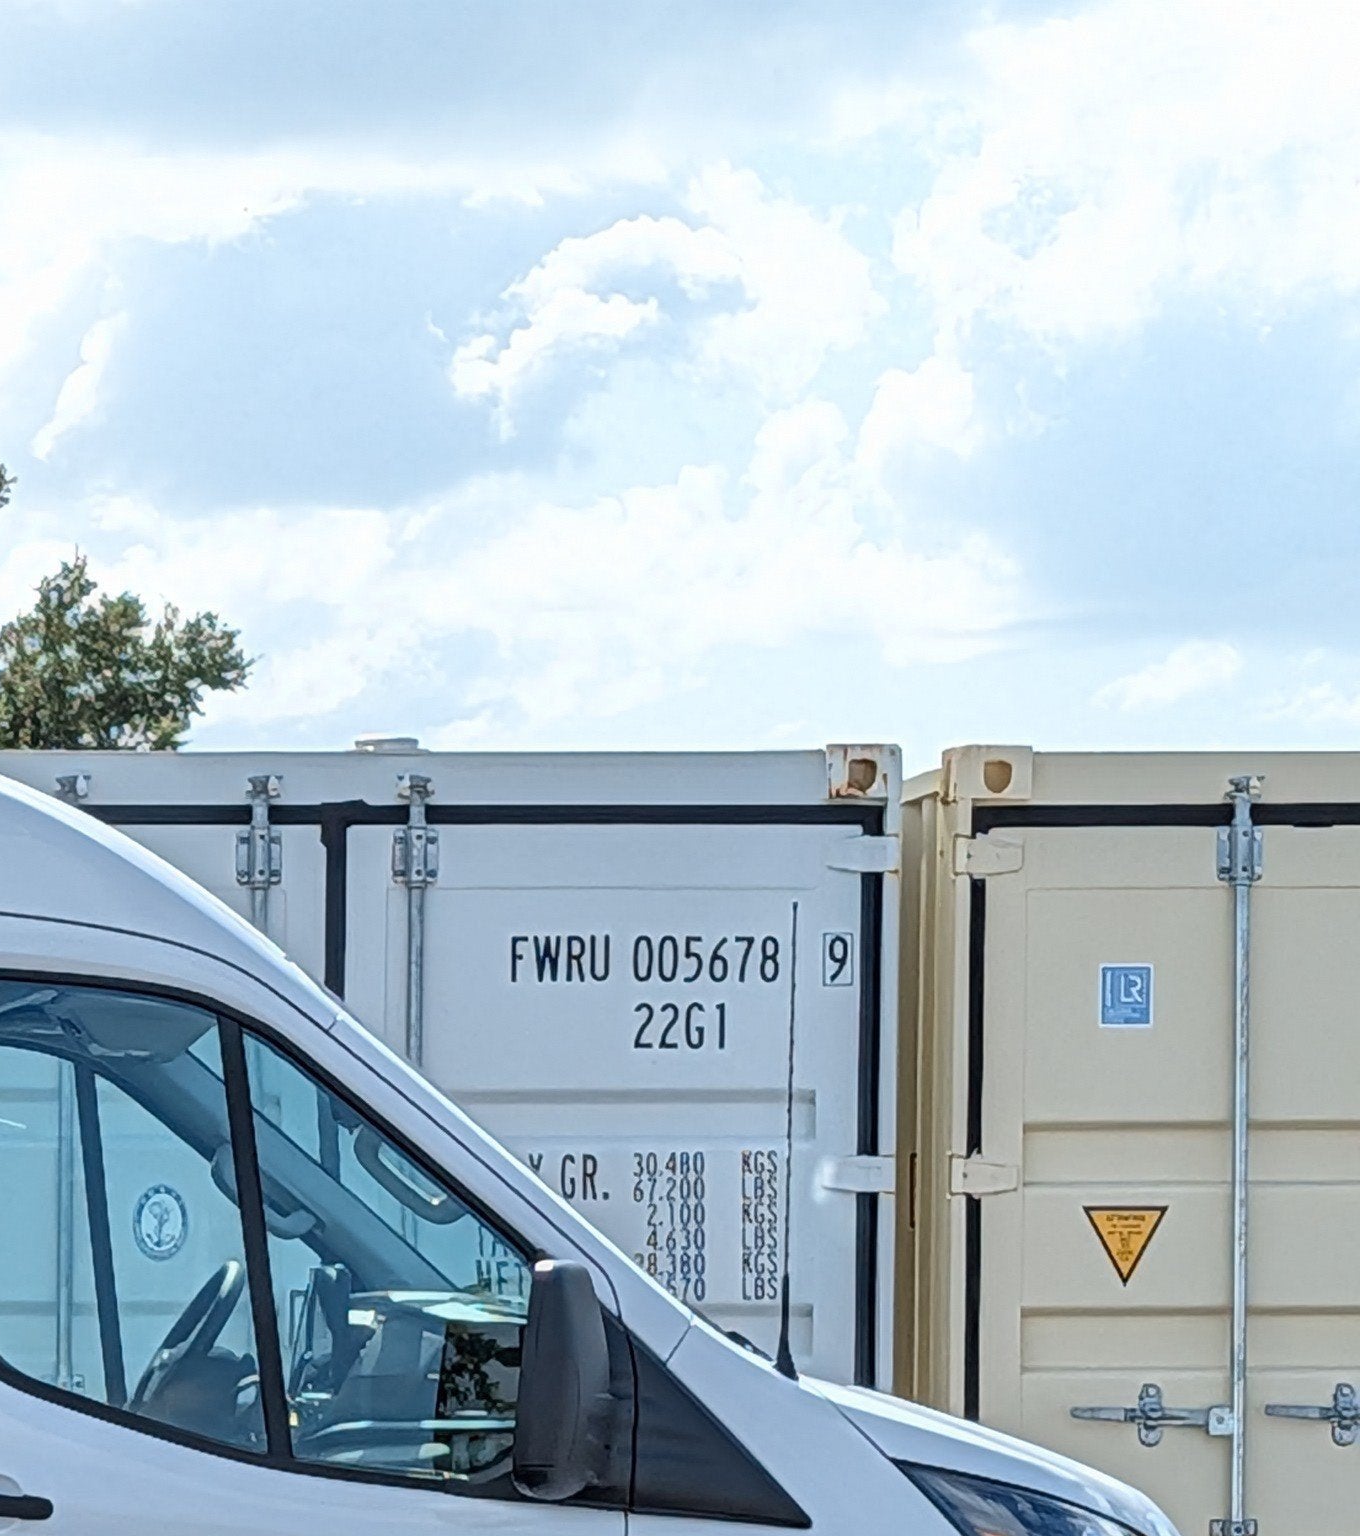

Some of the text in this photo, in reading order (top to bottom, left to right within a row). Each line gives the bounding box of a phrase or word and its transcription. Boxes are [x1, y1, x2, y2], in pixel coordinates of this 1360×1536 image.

[509, 935, 849, 983] FWRU 005678 9
[632, 1001, 727, 1050] 22G1
[632, 1150, 778, 1177] 30.480 KGS
[632, 1176, 778, 1202] 67.200 LBS
[646, 1200, 778, 1227] 2.100 KGS
[645, 1225, 778, 1252] 4.630 LBS
[741, 1251, 778, 1275] KGS
[741, 1275, 778, 1301] LBS
